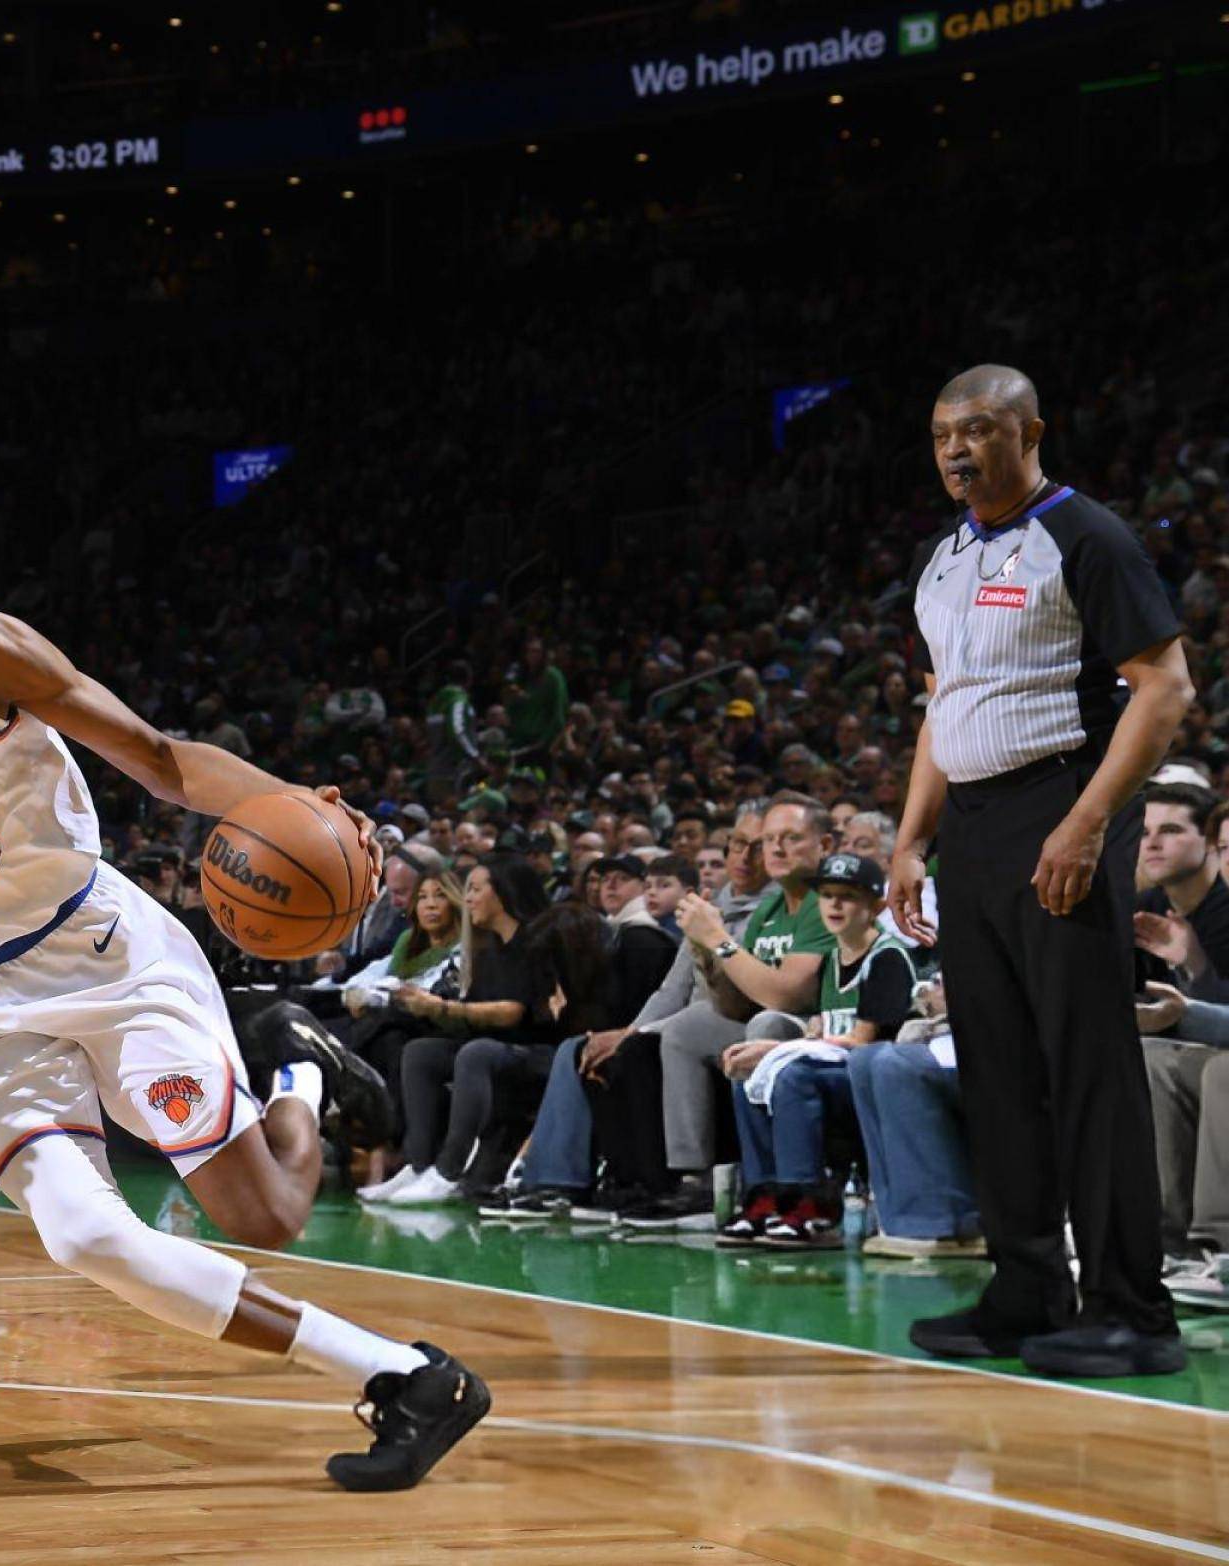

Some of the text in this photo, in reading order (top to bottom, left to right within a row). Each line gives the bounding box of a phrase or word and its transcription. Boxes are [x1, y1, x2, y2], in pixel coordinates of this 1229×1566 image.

[630, 59, 690, 97] We
[695, 45, 776, 87] help
[782, 25, 887, 73] make
[905, 18, 937, 47] TD
[49, 141, 107, 171] 3:02
[114, 137, 159, 166] PM
[977, 590, 1025, 605] Emirates
[206, 832, 292, 905] Wilson
